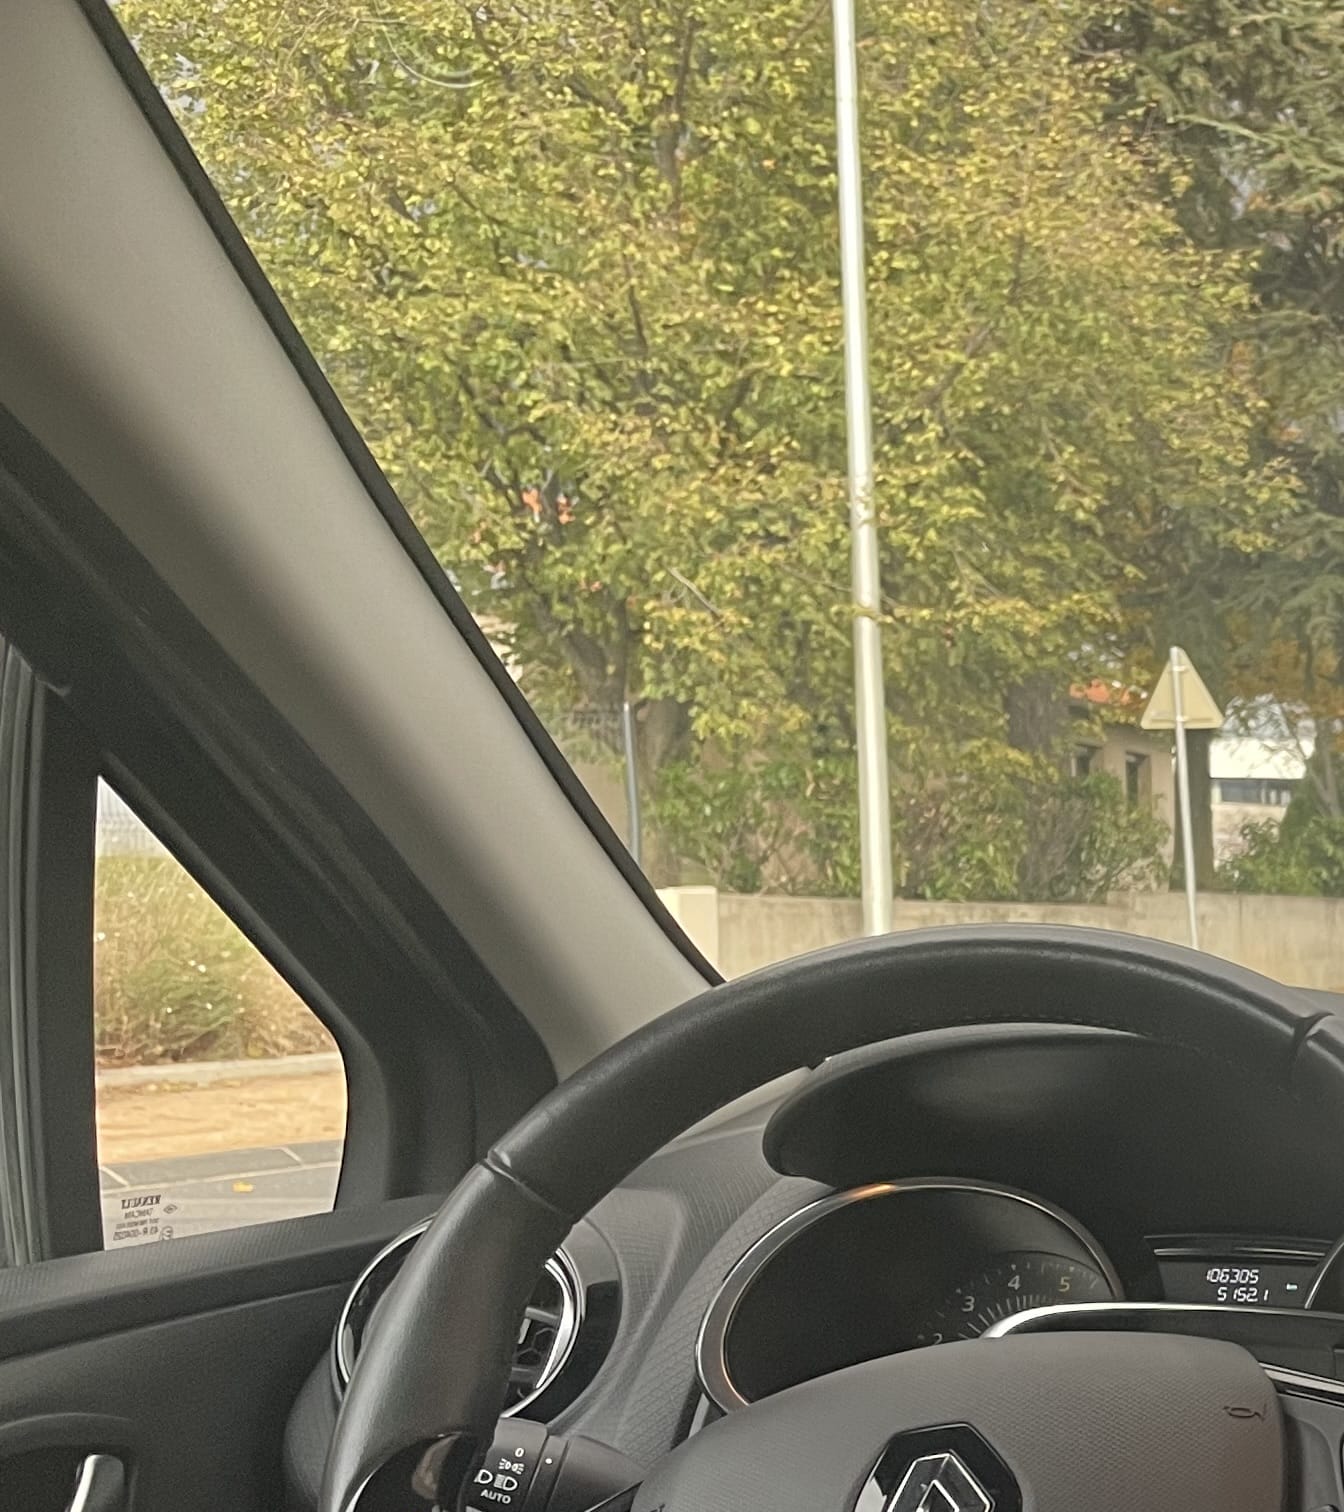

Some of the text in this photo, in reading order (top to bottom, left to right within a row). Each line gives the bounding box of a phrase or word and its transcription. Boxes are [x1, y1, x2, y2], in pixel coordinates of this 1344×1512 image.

[1008, 1275, 1021, 1291] 4
[1058, 1276, 1071, 1292] 5
[1206, 1268, 1260, 1284] 106305
[962, 1295, 975, 1313] 3
[480, 1488, 512, 1504] AUTO
